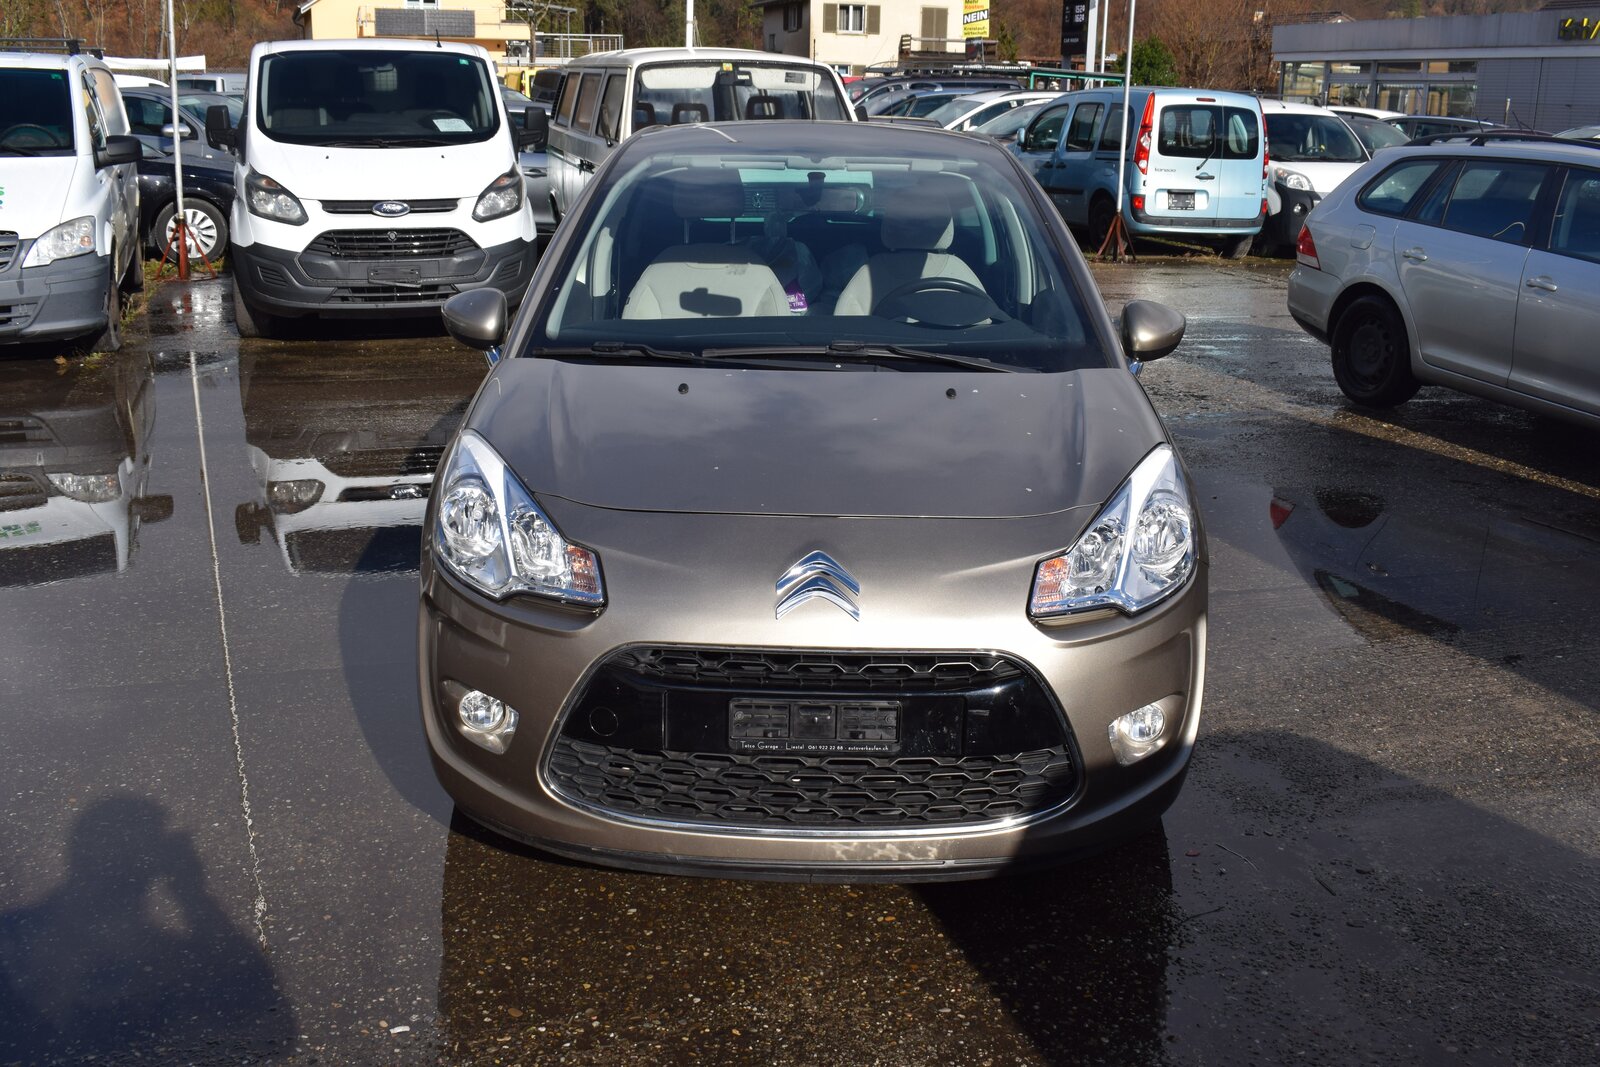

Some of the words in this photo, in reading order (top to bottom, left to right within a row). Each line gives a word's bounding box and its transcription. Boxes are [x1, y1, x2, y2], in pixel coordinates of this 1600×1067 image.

[963, 9, 988, 24] NEIN
[757, 741, 779, 751] Garage
[785, 742, 805, 750] Liestal
